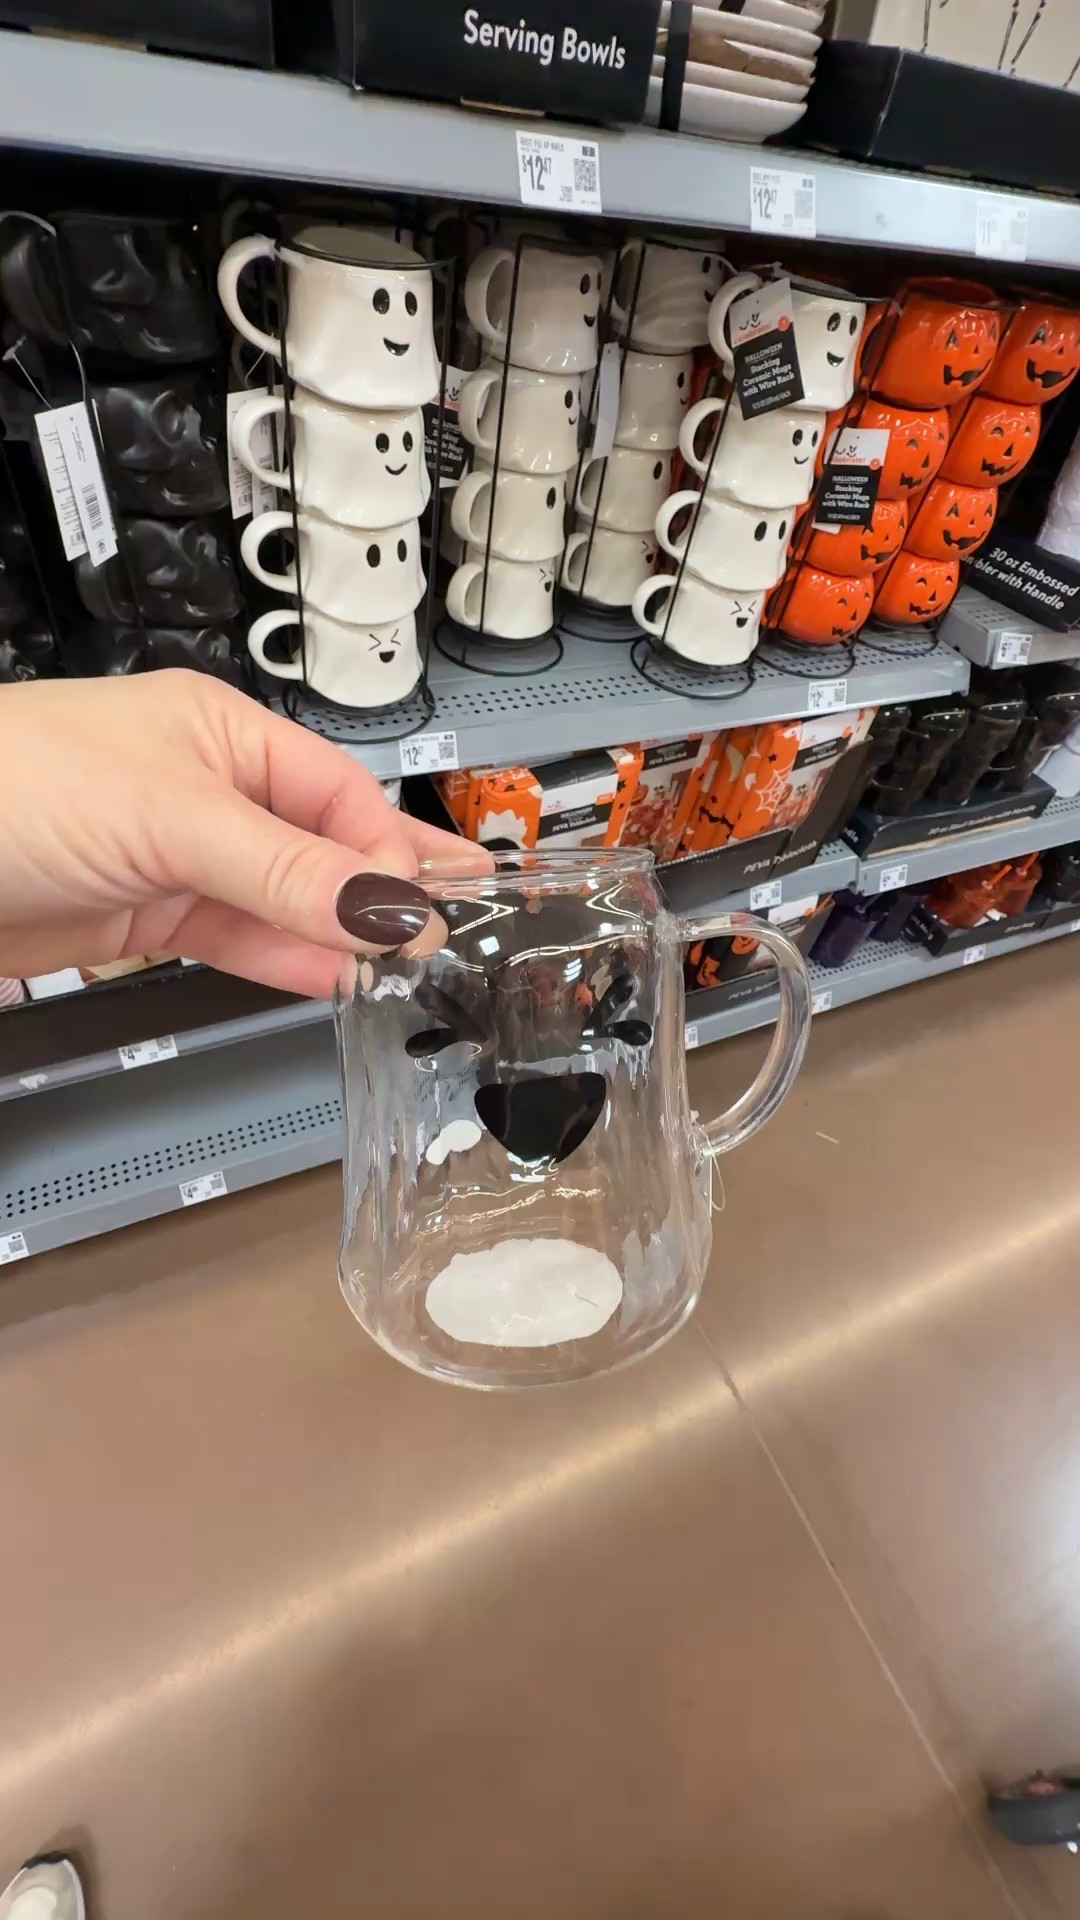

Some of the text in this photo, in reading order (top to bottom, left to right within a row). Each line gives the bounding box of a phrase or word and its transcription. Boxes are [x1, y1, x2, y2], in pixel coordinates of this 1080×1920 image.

[463, 8, 626, 69] Serving Bowls
[744, 342, 783, 363] HALLOWEEN
[743, 362, 792, 387] Ceramic Mugs
[750, 357, 781, 375] Stacking
[743, 371, 795, 397] with Wire Rack
[825, 492, 870, 502] Ceramic Mugs
[834, 484, 863, 494] Stacking
[837, 500, 853, 508] Wire
[854, 501, 870, 509] Rack
[989, 547, 1080, 597] 30 oz Embossed
[997, 571, 1023, 589] with
[1021, 582, 1065, 610] Handle
[743, 858, 771, 875] PEVA
